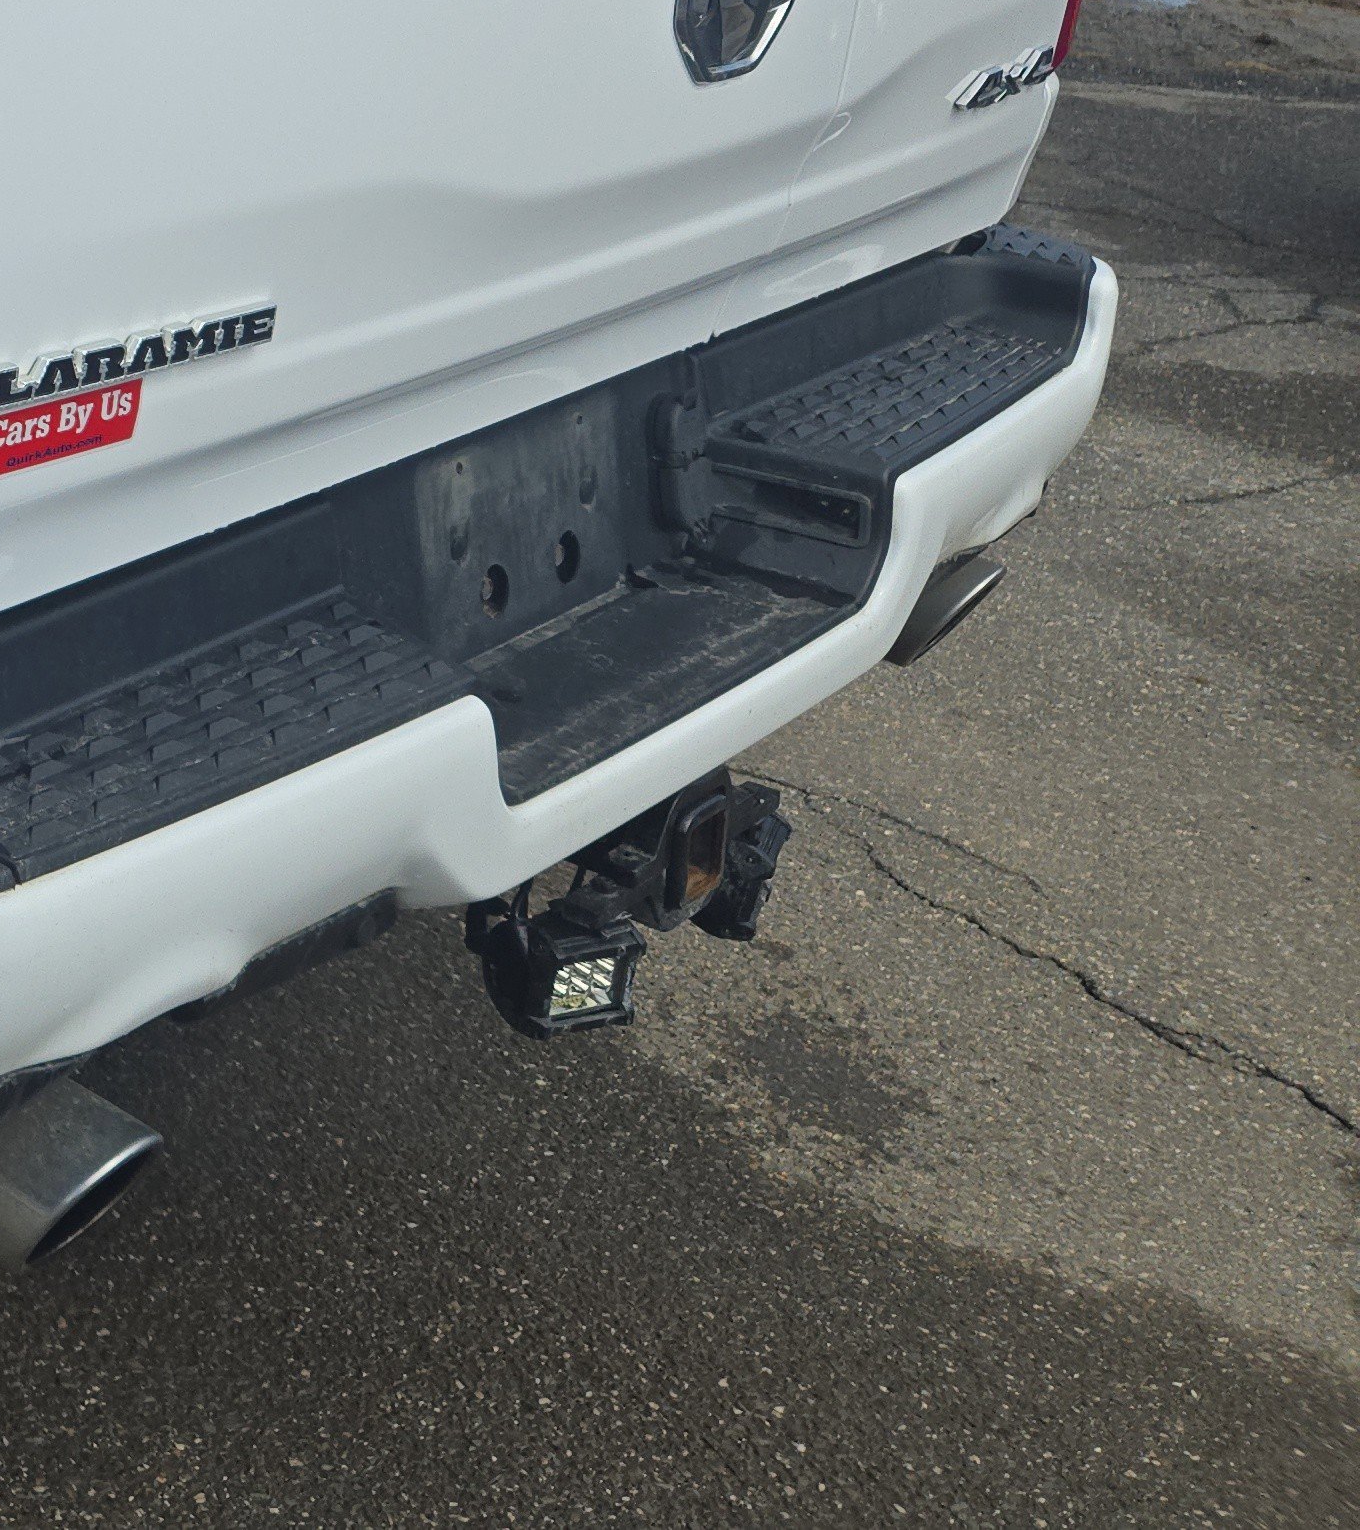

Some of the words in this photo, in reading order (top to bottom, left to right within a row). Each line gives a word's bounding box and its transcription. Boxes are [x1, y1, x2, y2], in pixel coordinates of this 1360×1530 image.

[57, 400, 94, 434] By
[101, 389, 133, 421] Us
[5, 433, 103, 468] QuirkAuto.com
